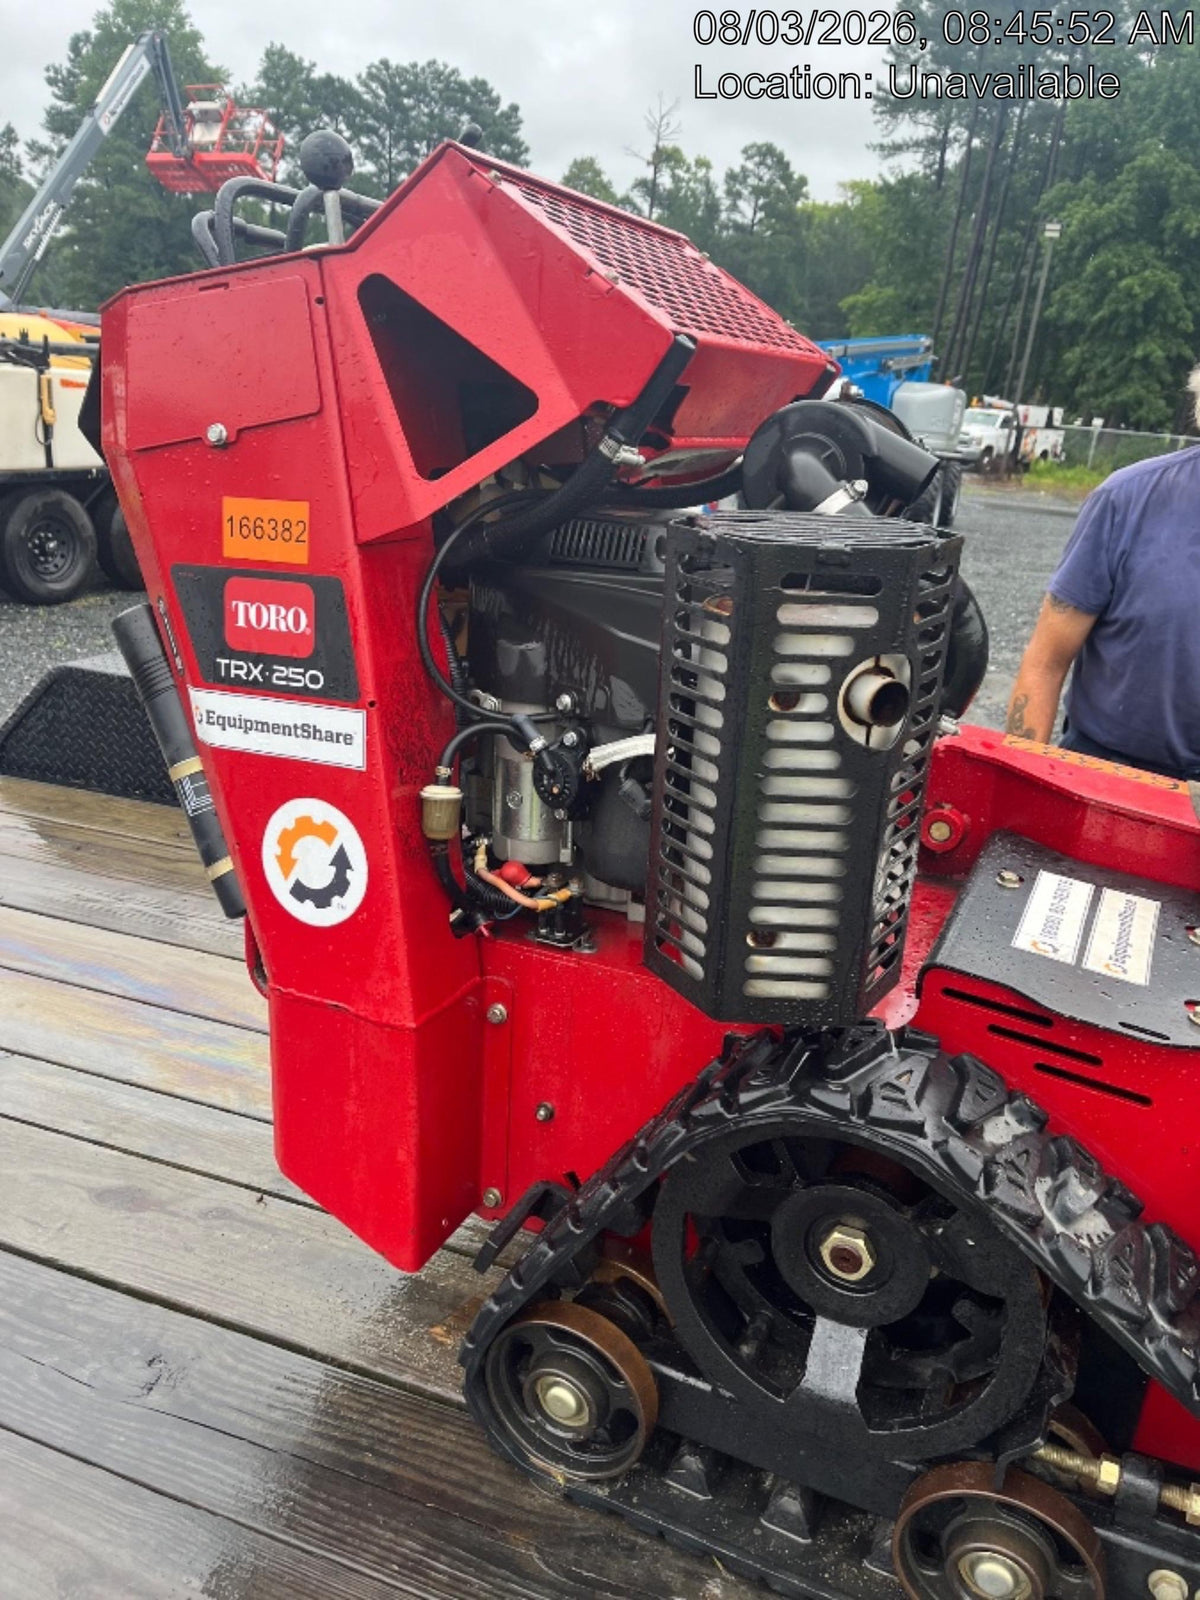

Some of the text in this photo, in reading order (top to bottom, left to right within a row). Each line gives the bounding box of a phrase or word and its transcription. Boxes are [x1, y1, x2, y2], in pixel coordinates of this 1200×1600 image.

[226, 516, 307, 543] 166382
[232, 600, 308, 634] TORO
[205, 709, 354, 746] EquipmentShare
